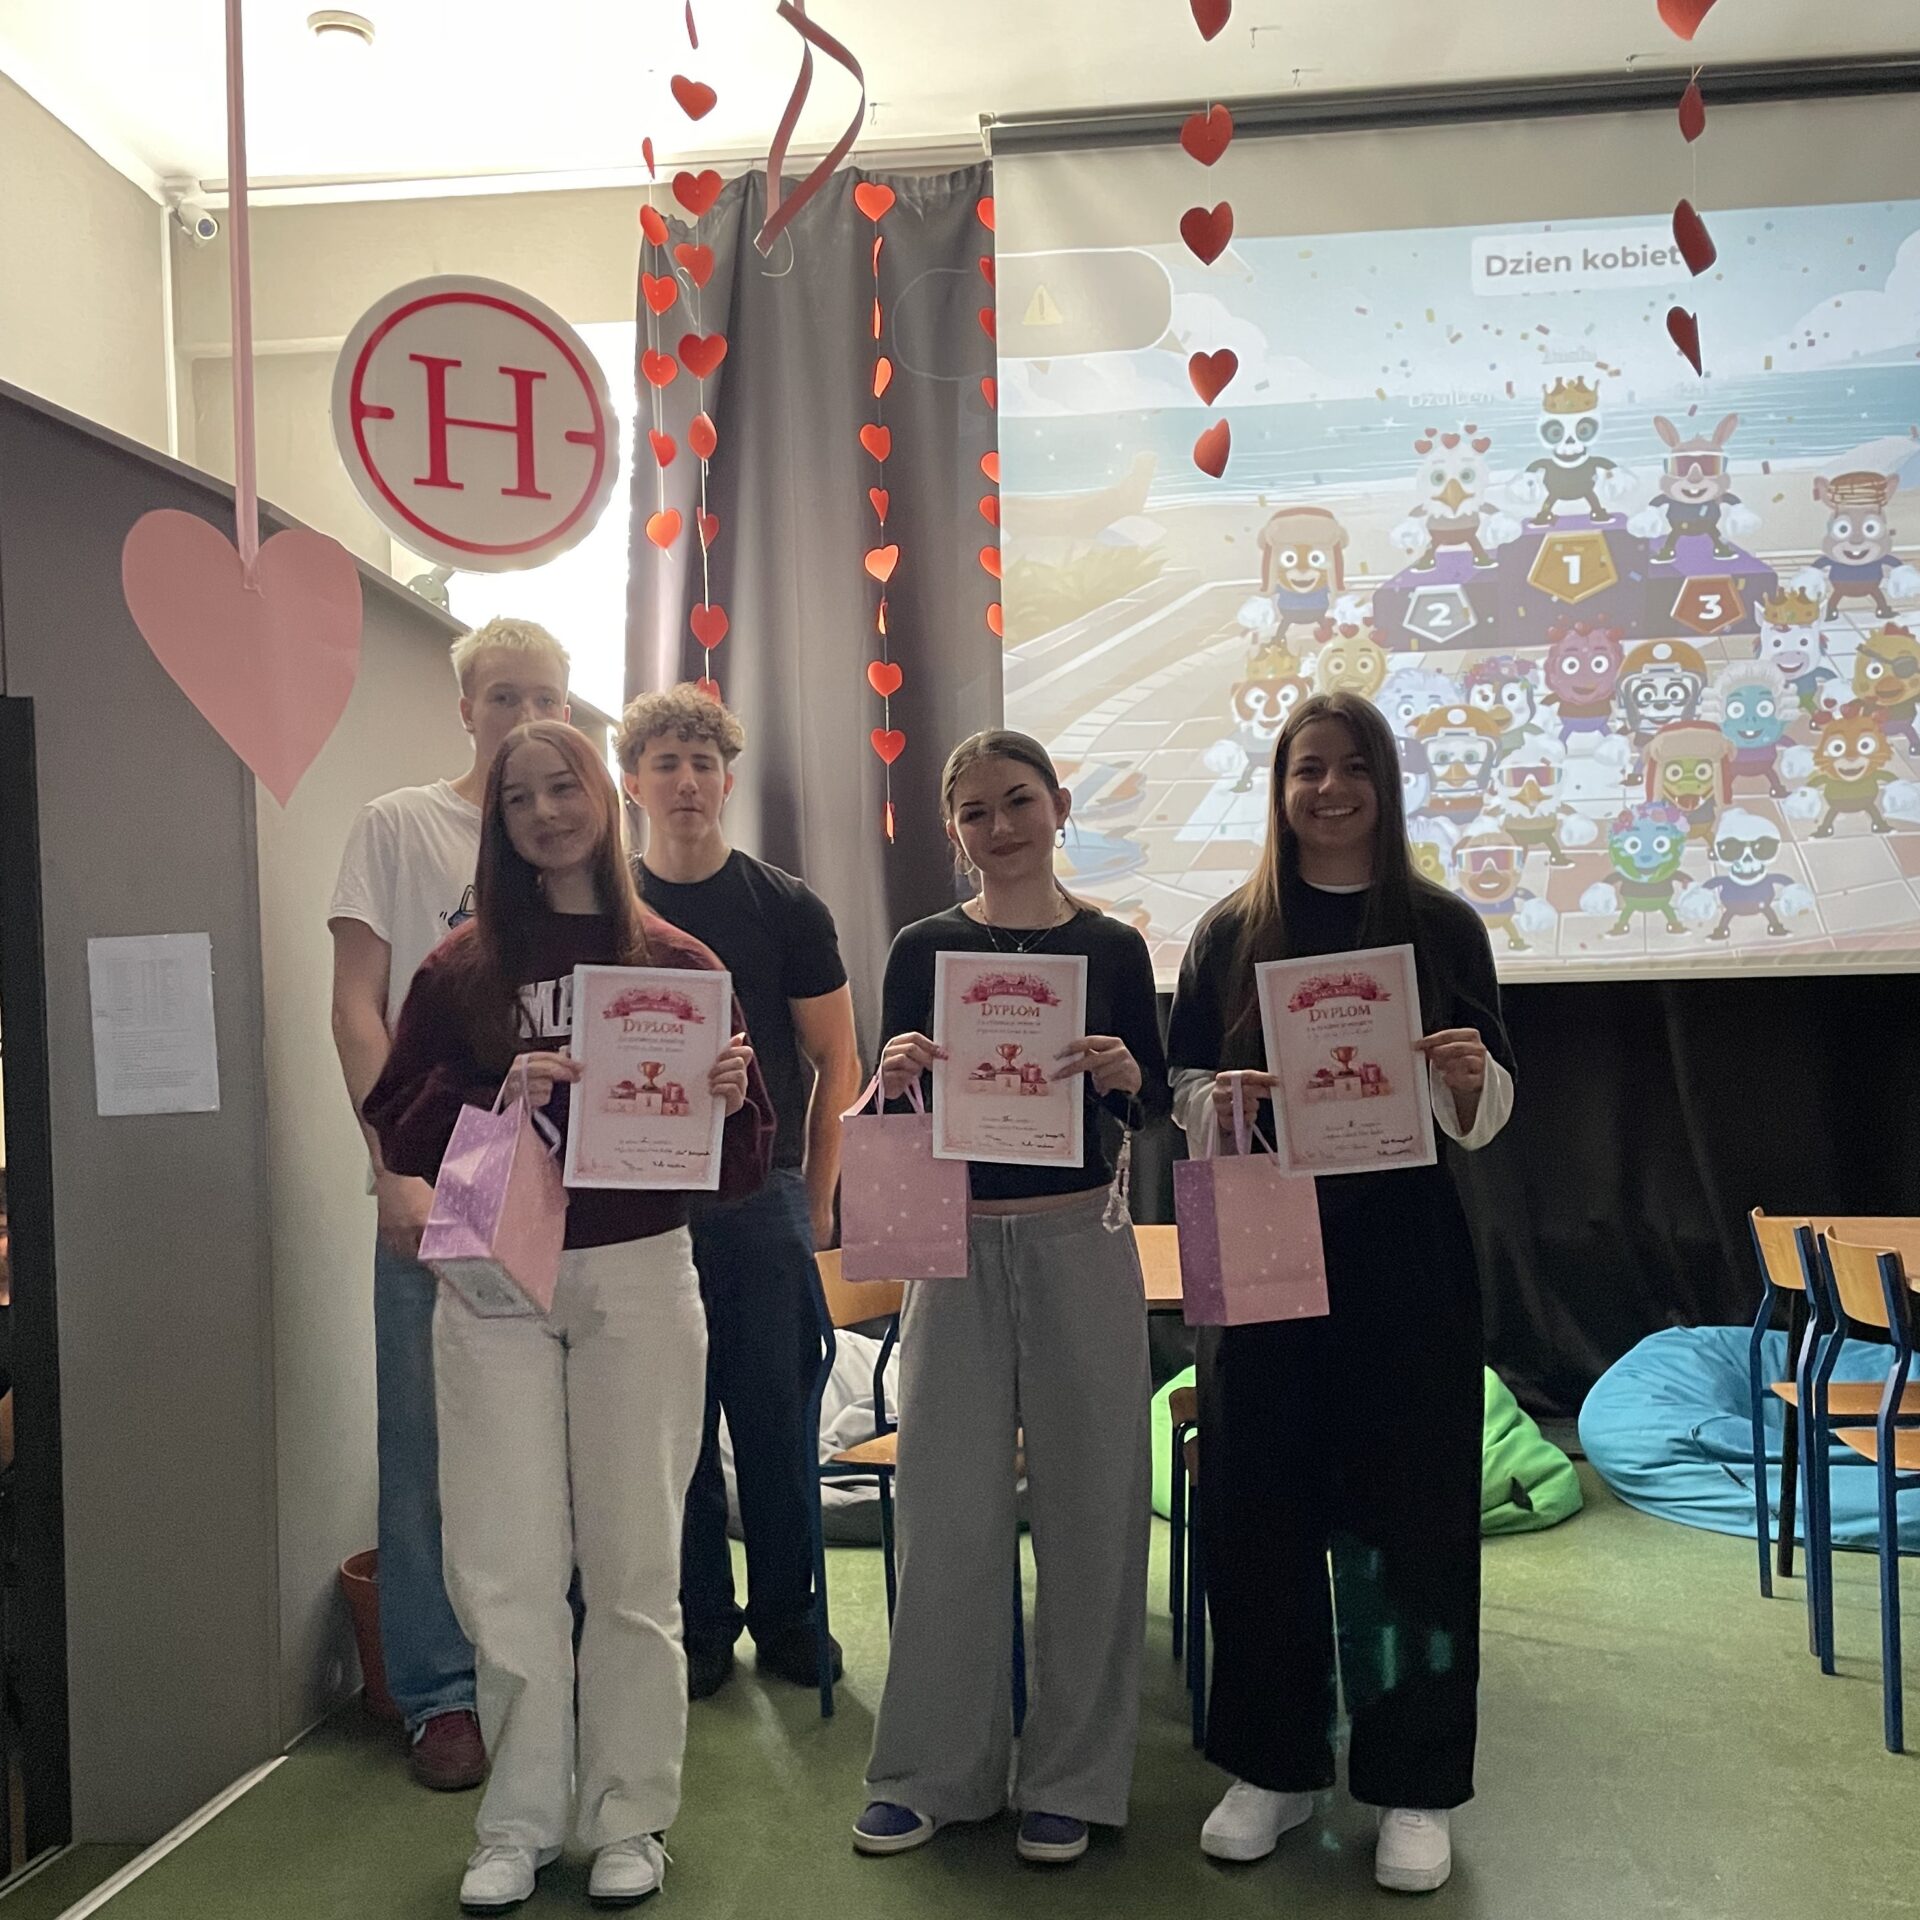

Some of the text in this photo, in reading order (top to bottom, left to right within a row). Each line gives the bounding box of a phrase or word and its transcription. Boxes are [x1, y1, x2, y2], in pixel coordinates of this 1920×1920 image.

[1485, 244, 1681, 277] Dzien kobiet
[409, 353, 552, 500] H
[1562, 554, 1581, 585] 1
[1426, 602, 1452, 627] 2
[1698, 594, 1722, 620] 3
[981, 1003, 1040, 1018] DYPLOM
[1309, 1004, 1371, 1023] DYPLOM
[622, 1018, 685, 1035] DYPLOM
